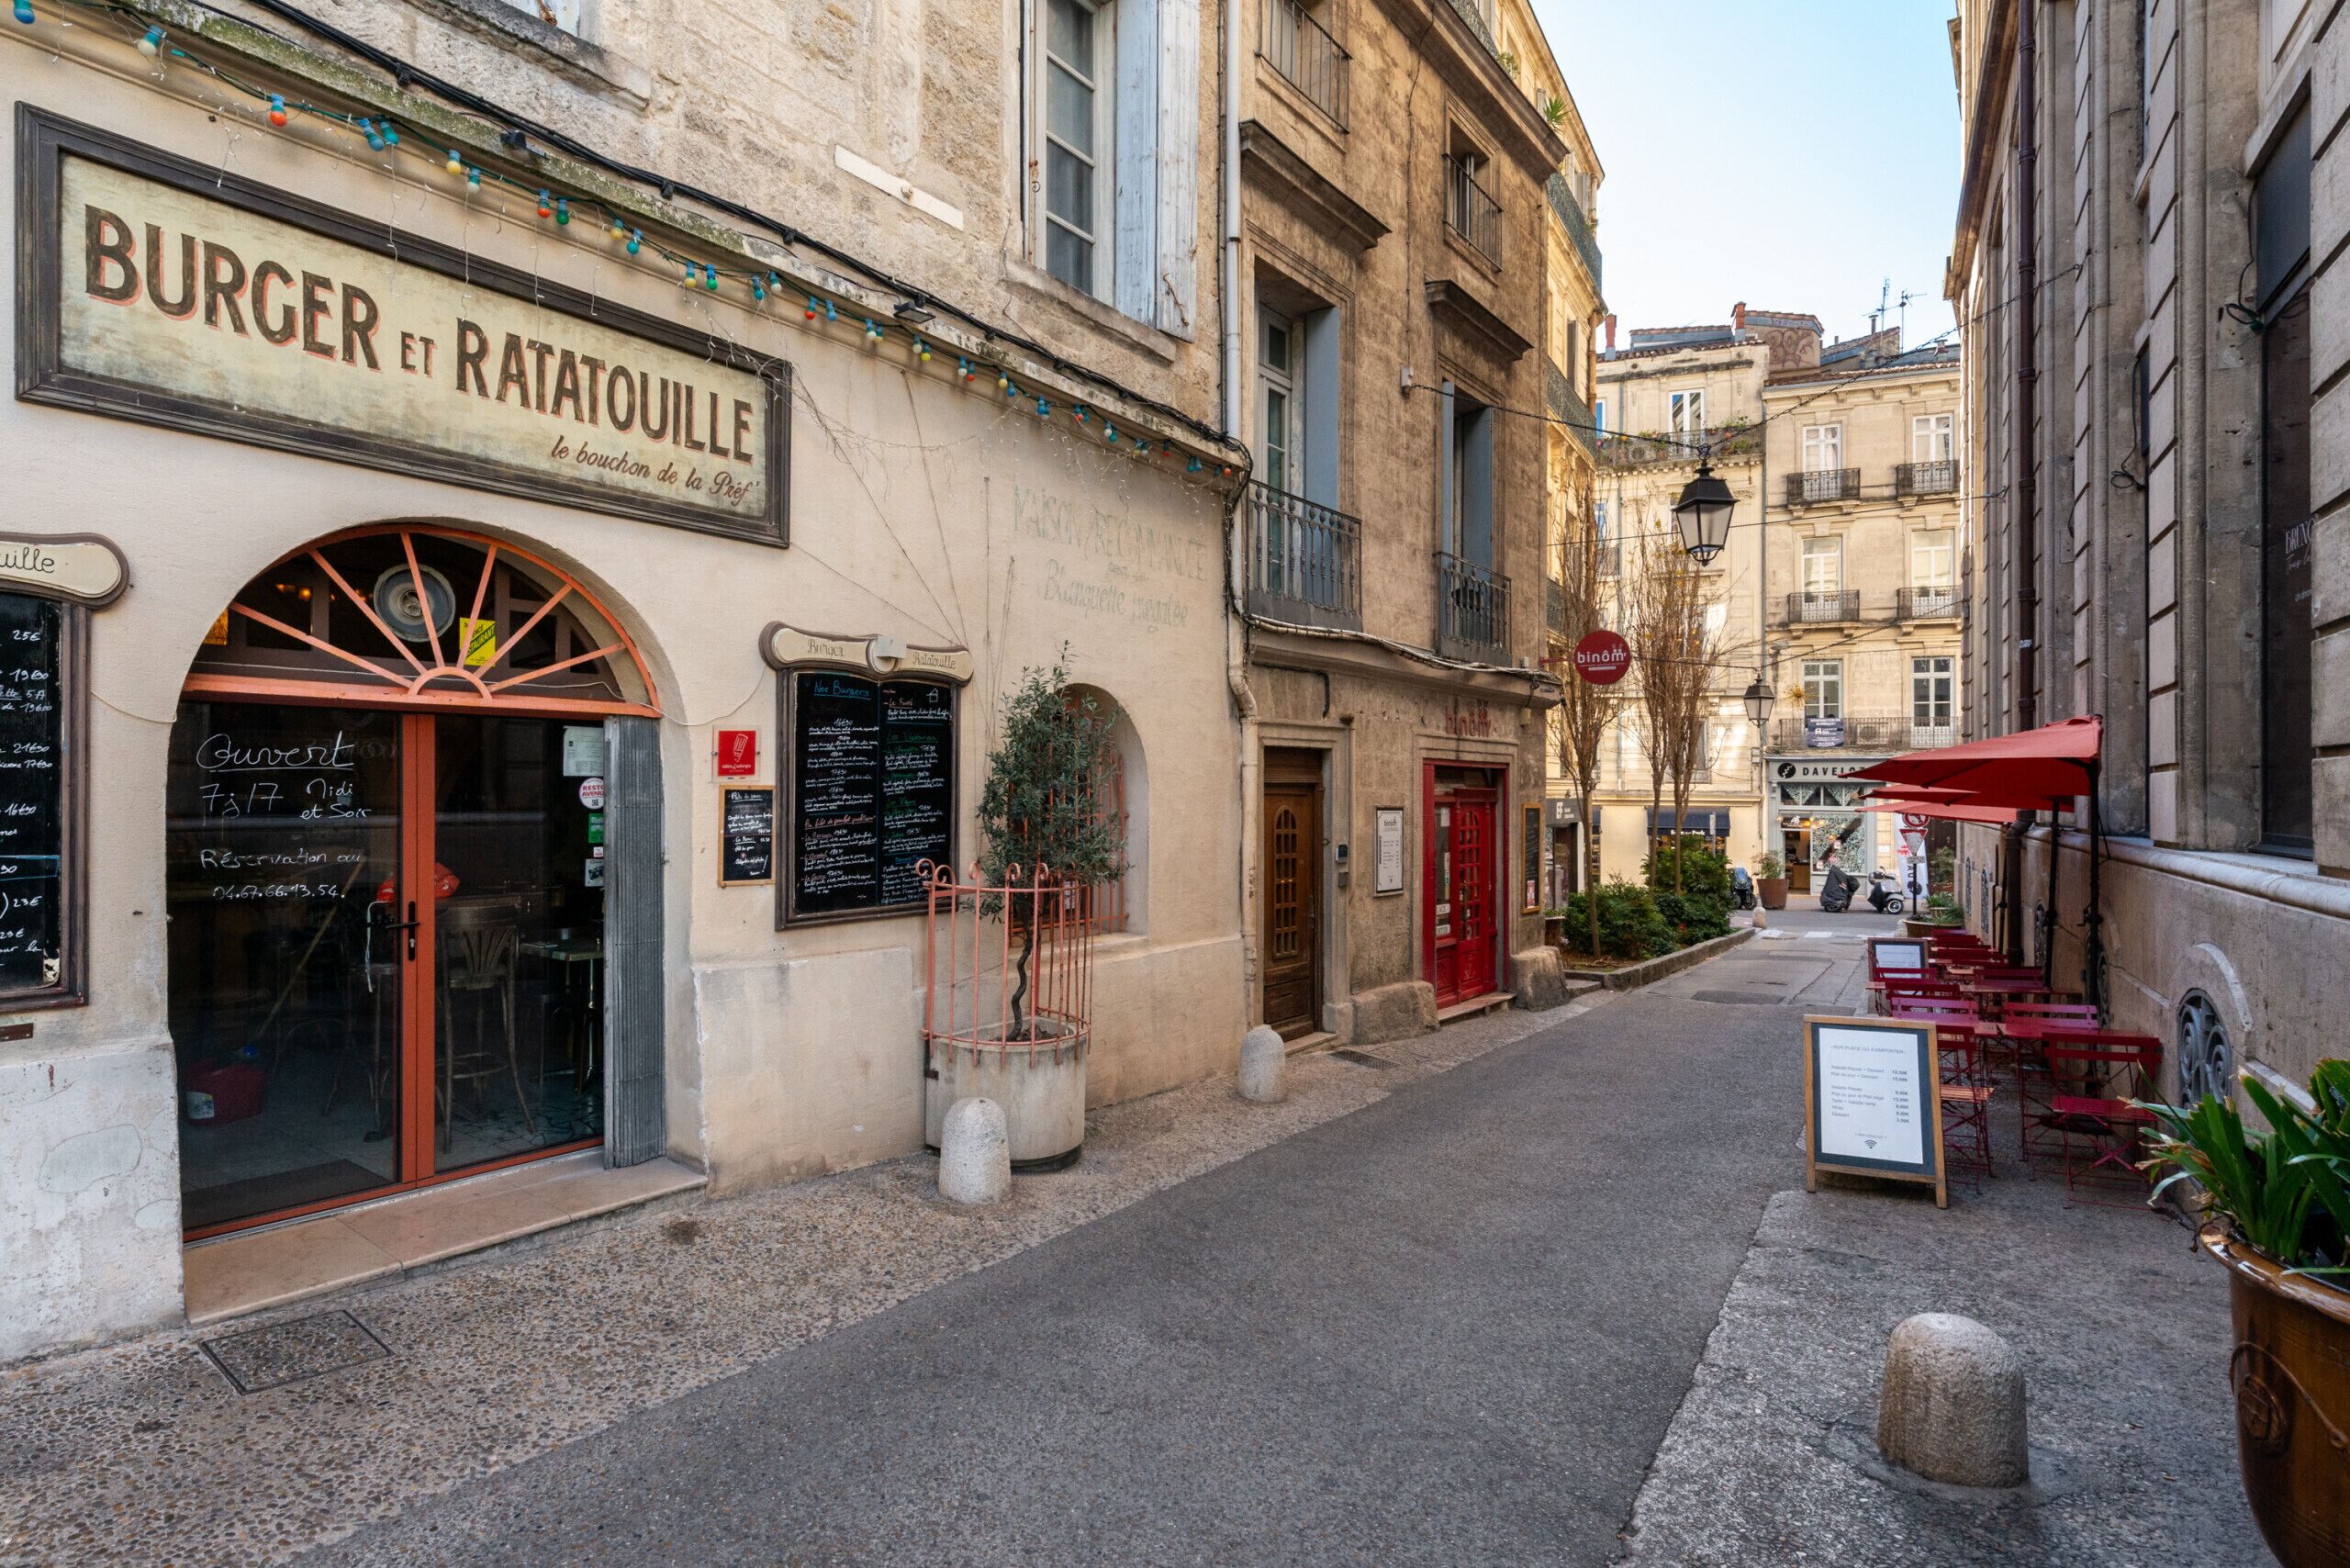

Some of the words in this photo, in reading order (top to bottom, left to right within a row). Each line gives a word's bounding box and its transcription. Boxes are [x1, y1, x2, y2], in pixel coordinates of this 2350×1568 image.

[84, 203, 380, 371] BURGER
[400, 331, 436, 375] ET
[456, 317, 755, 464] RATATOUILLE
[551, 434, 569, 458] le
[576, 442, 650, 478] bouchon
[657, 462, 677, 484] de
[686, 467, 702, 490] la
[13, 630, 41, 641] 25€
[808, 639, 845, 657] Burger
[196, 731, 354, 768] Ouvert
[199, 783, 284, 819] 7j/7
[299, 804, 323, 819] et
[329, 804, 372, 819] Soir
[200, 847, 327, 868] Réservation
